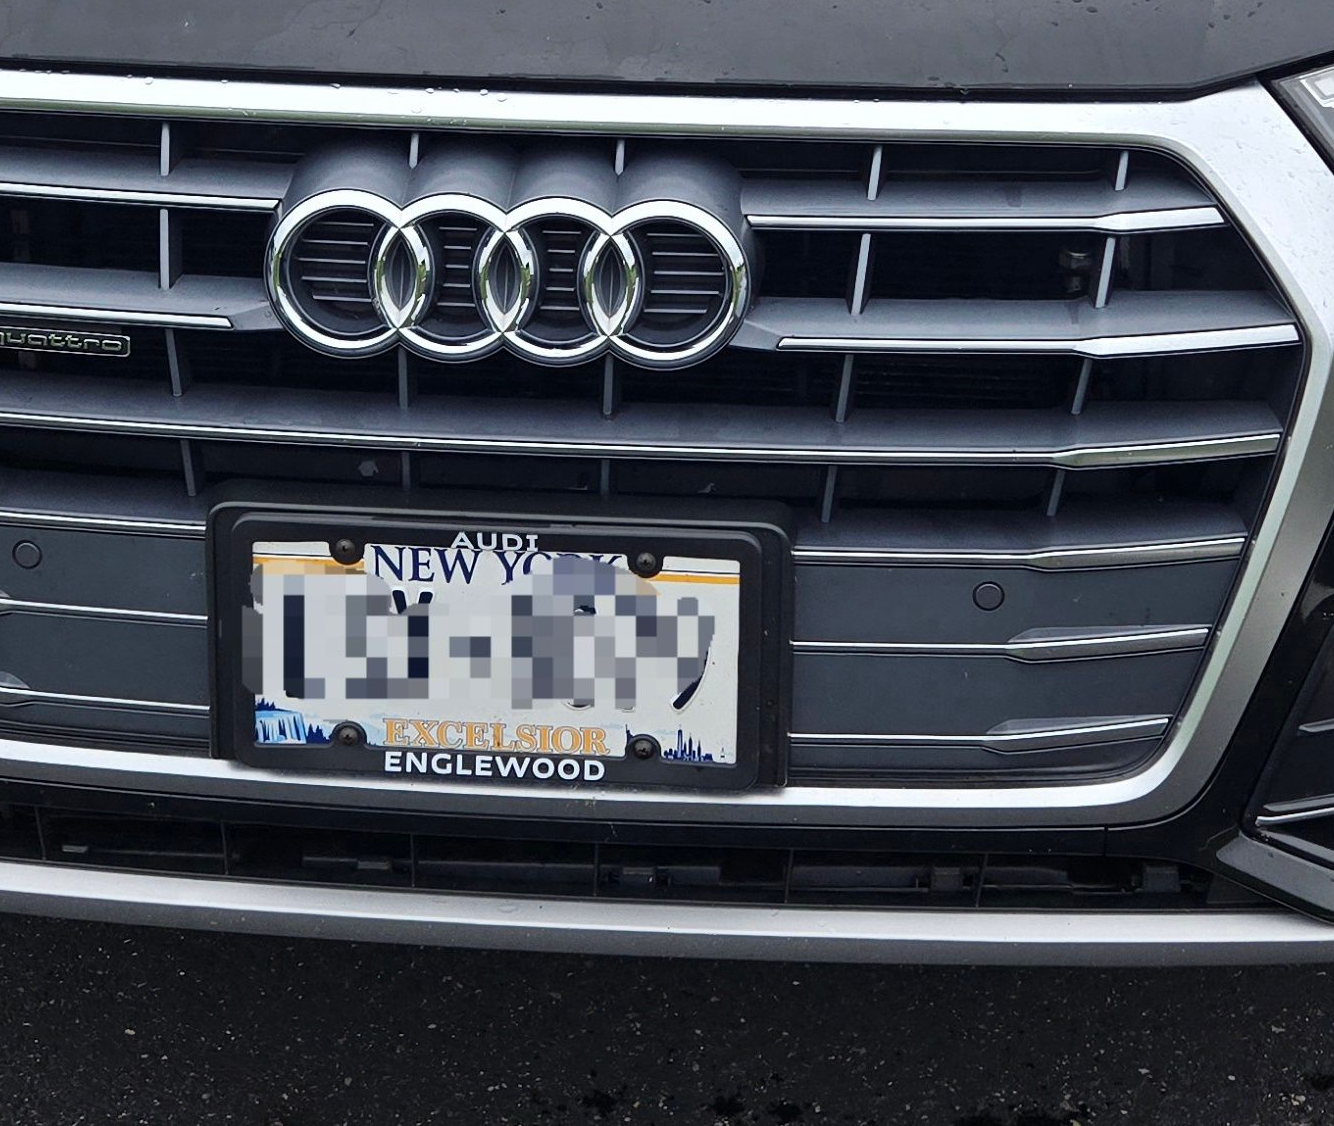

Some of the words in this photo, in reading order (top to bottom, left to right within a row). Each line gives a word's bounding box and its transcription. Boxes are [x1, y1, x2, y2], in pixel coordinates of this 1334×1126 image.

[450, 531, 539, 552] AUDI
[370, 545, 480, 585] NEW
[383, 717, 611, 756] EXCELSIOR
[384, 750, 605, 781] ENGLEWOOD
